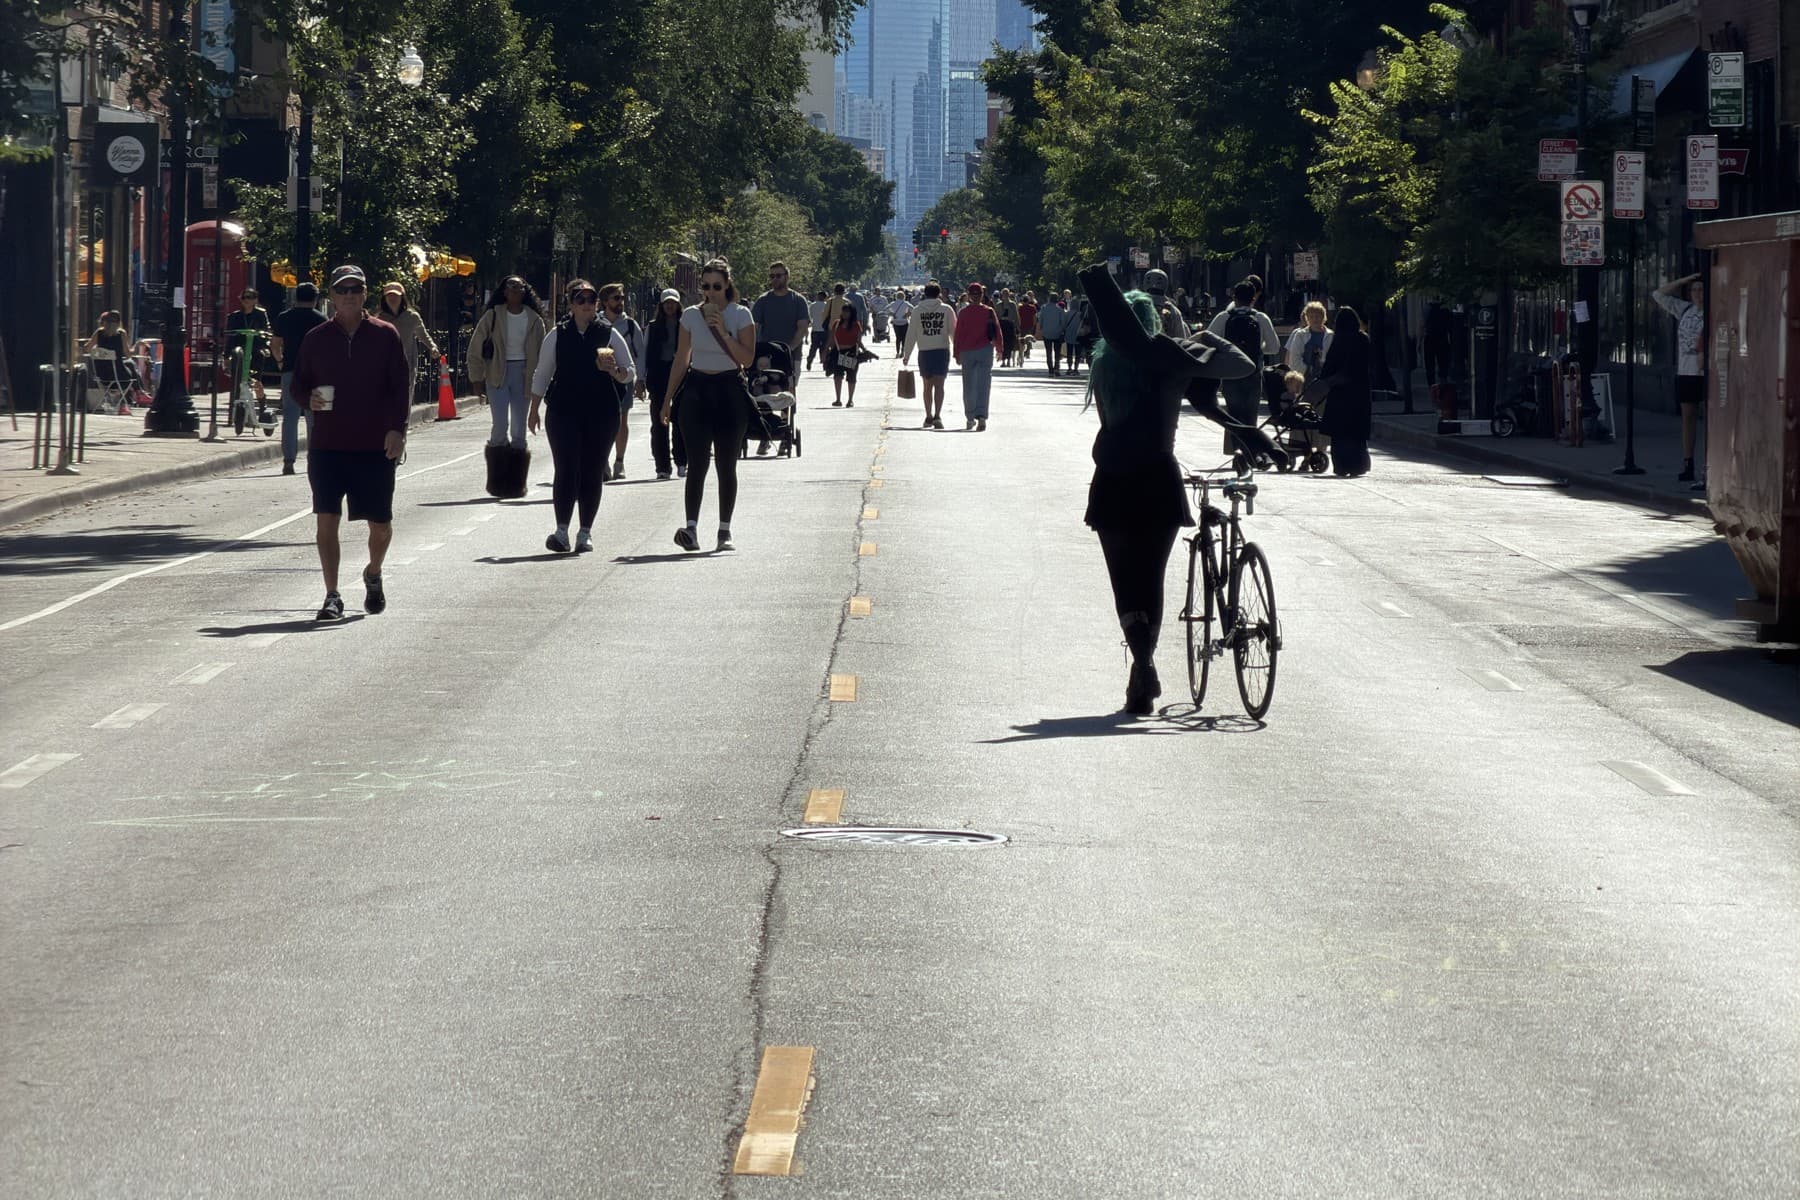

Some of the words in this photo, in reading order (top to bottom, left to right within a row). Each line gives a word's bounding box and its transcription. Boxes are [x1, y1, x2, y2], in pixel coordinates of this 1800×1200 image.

[920, 312, 945, 320] HAPPY
[921, 320, 932, 328] TO
[932, 320, 944, 328] BE
[923, 328, 941, 336] ALIVE
